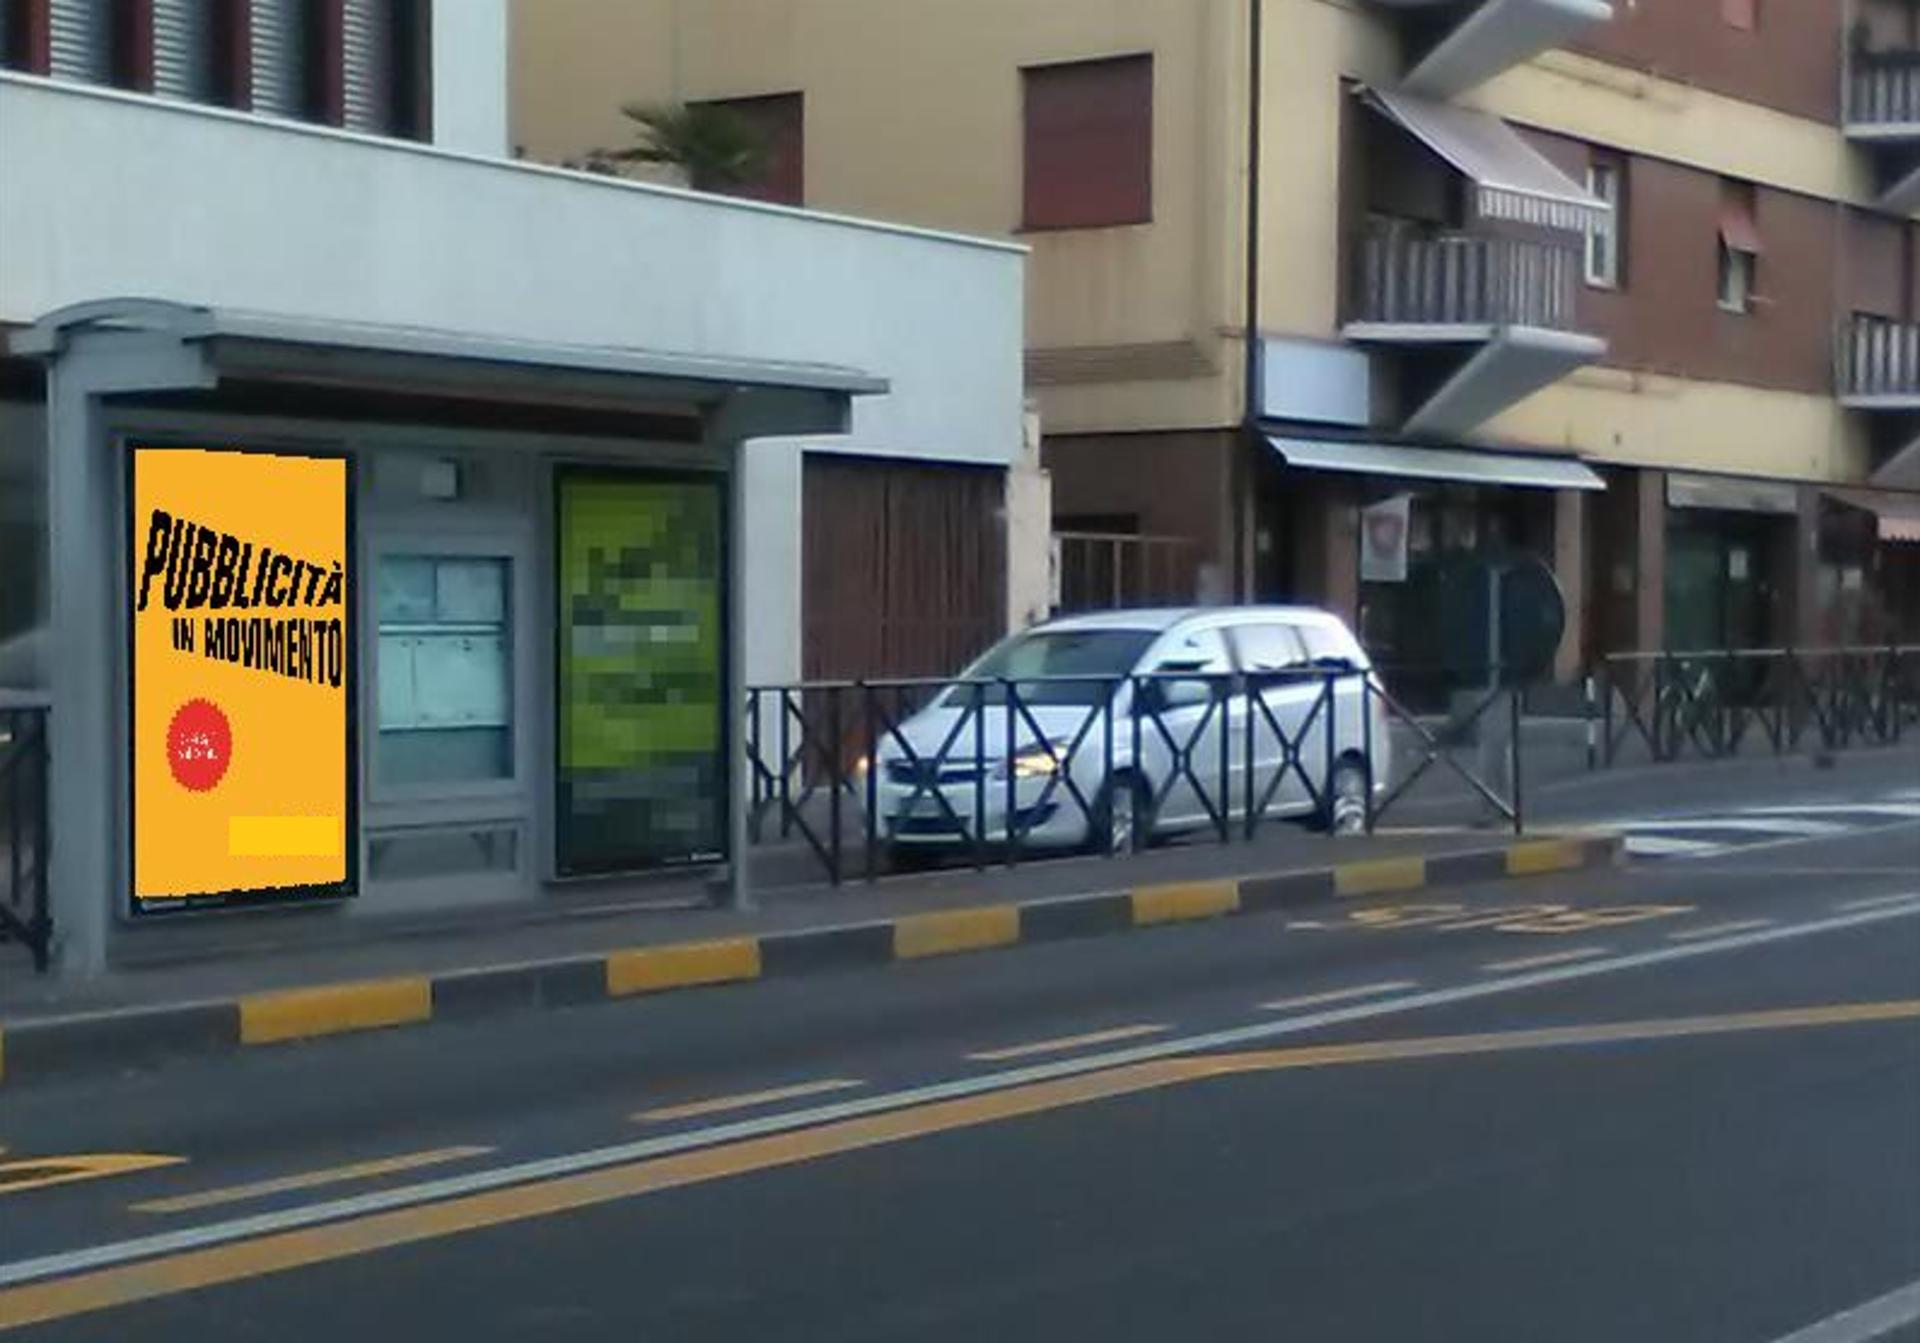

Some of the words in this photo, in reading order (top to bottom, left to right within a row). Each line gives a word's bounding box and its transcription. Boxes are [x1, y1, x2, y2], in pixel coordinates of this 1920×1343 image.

[137, 509, 343, 611] PUBBLICITÀ
[172, 617, 194, 652] IN
[204, 617, 342, 688] MOVIMENTO
